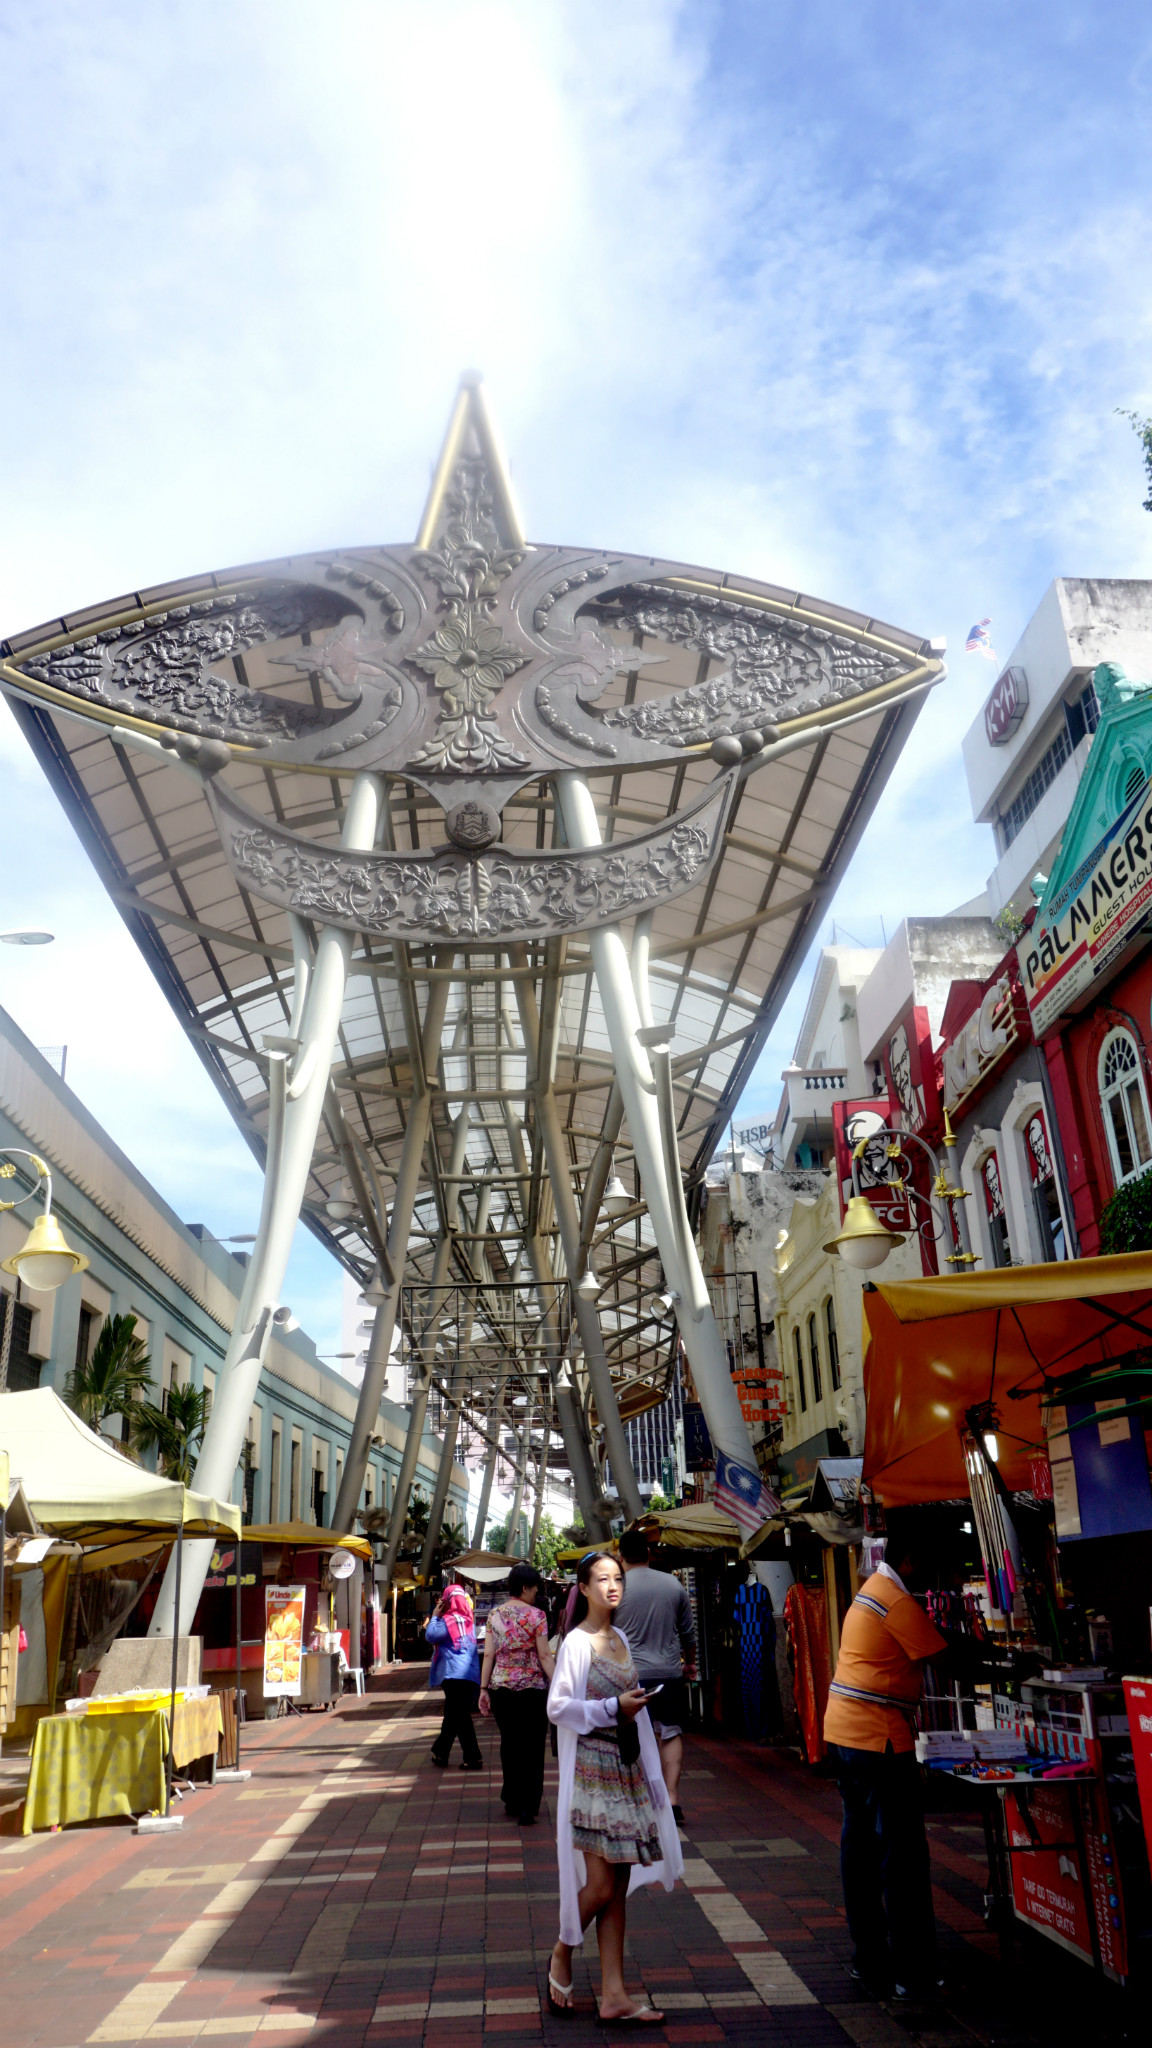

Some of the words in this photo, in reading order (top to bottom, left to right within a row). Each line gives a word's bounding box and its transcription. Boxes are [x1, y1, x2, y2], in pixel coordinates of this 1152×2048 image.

[986, 671, 1016, 743] KYH
[1048, 888, 1069, 921] RUMAH
[1068, 842, 1106, 895] TUMPANGAN
[1093, 891, 1126, 936] GUEST
[1095, 920, 1120, 950] WHERE
[942, 979, 1010, 1111] KFC
[873, 1205, 905, 1224] FC
[737, 1383, 780, 1401] Guest
[1055, 1912, 1076, 1937] GRATIS
